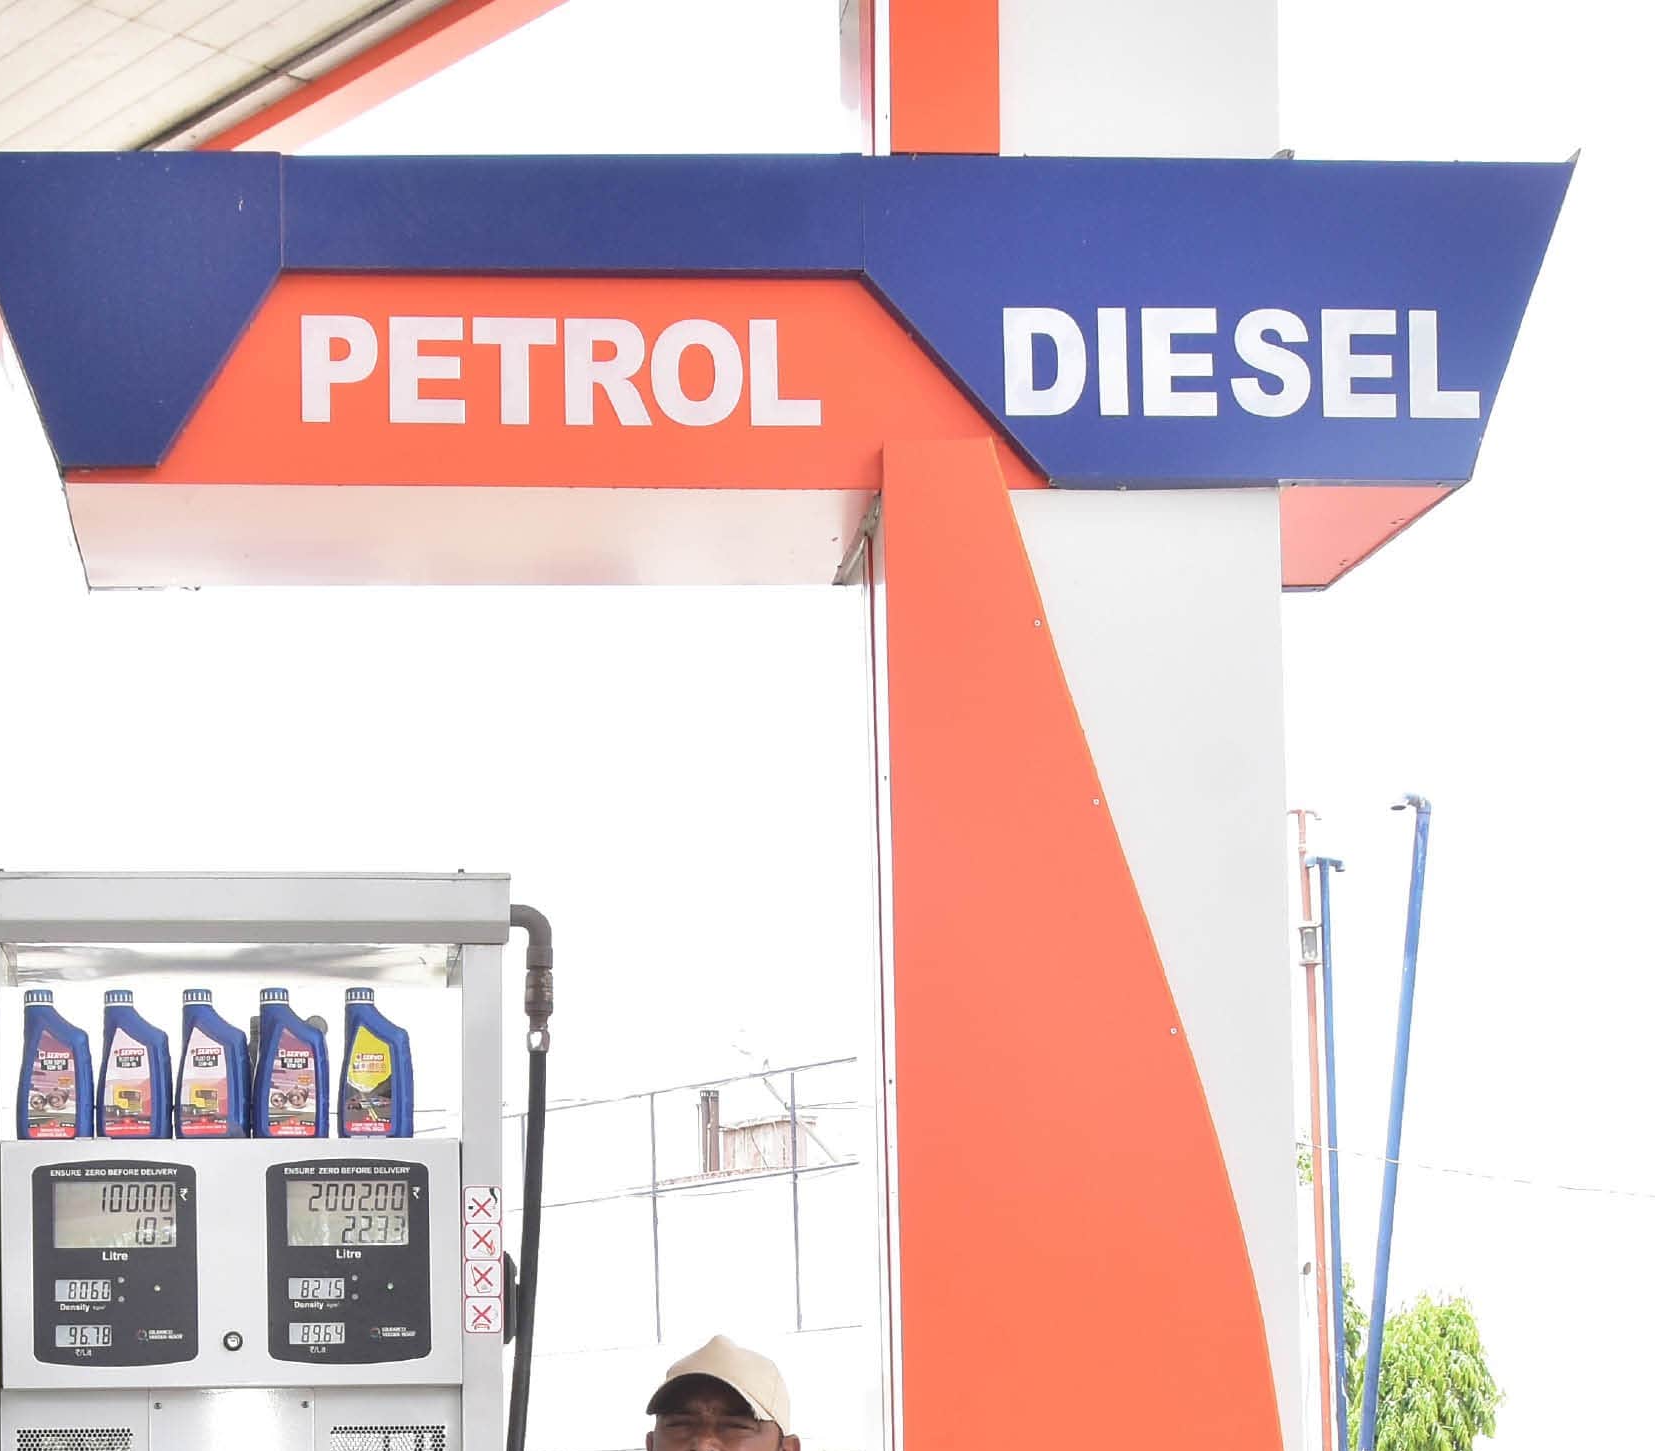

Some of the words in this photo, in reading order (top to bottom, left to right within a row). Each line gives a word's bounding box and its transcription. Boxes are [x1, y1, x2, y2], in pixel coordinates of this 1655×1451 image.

[1001, 306, 1481, 419] DIESEL
[299, 313, 823, 427] PETROL
[50, 1169, 82, 1177] ENSURE
[108, 1168, 139, 1176] BEFORE
[141, 1168, 178, 1176] DELIVERY
[284, 1167, 315, 1175] ENSURE
[318, 1167, 339, 1175] ZERO
[373, 1166, 411, 1174] DELIVERY
[102, 1184, 174, 1213] 100.00
[308, 1183, 406, 1212] 2002.00
[102, 1250, 129, 1261] Litre
[335, 1249, 362, 1259] Litre
[59, 1303, 90, 1313] Density
[294, 1301, 324, 1310] Density
